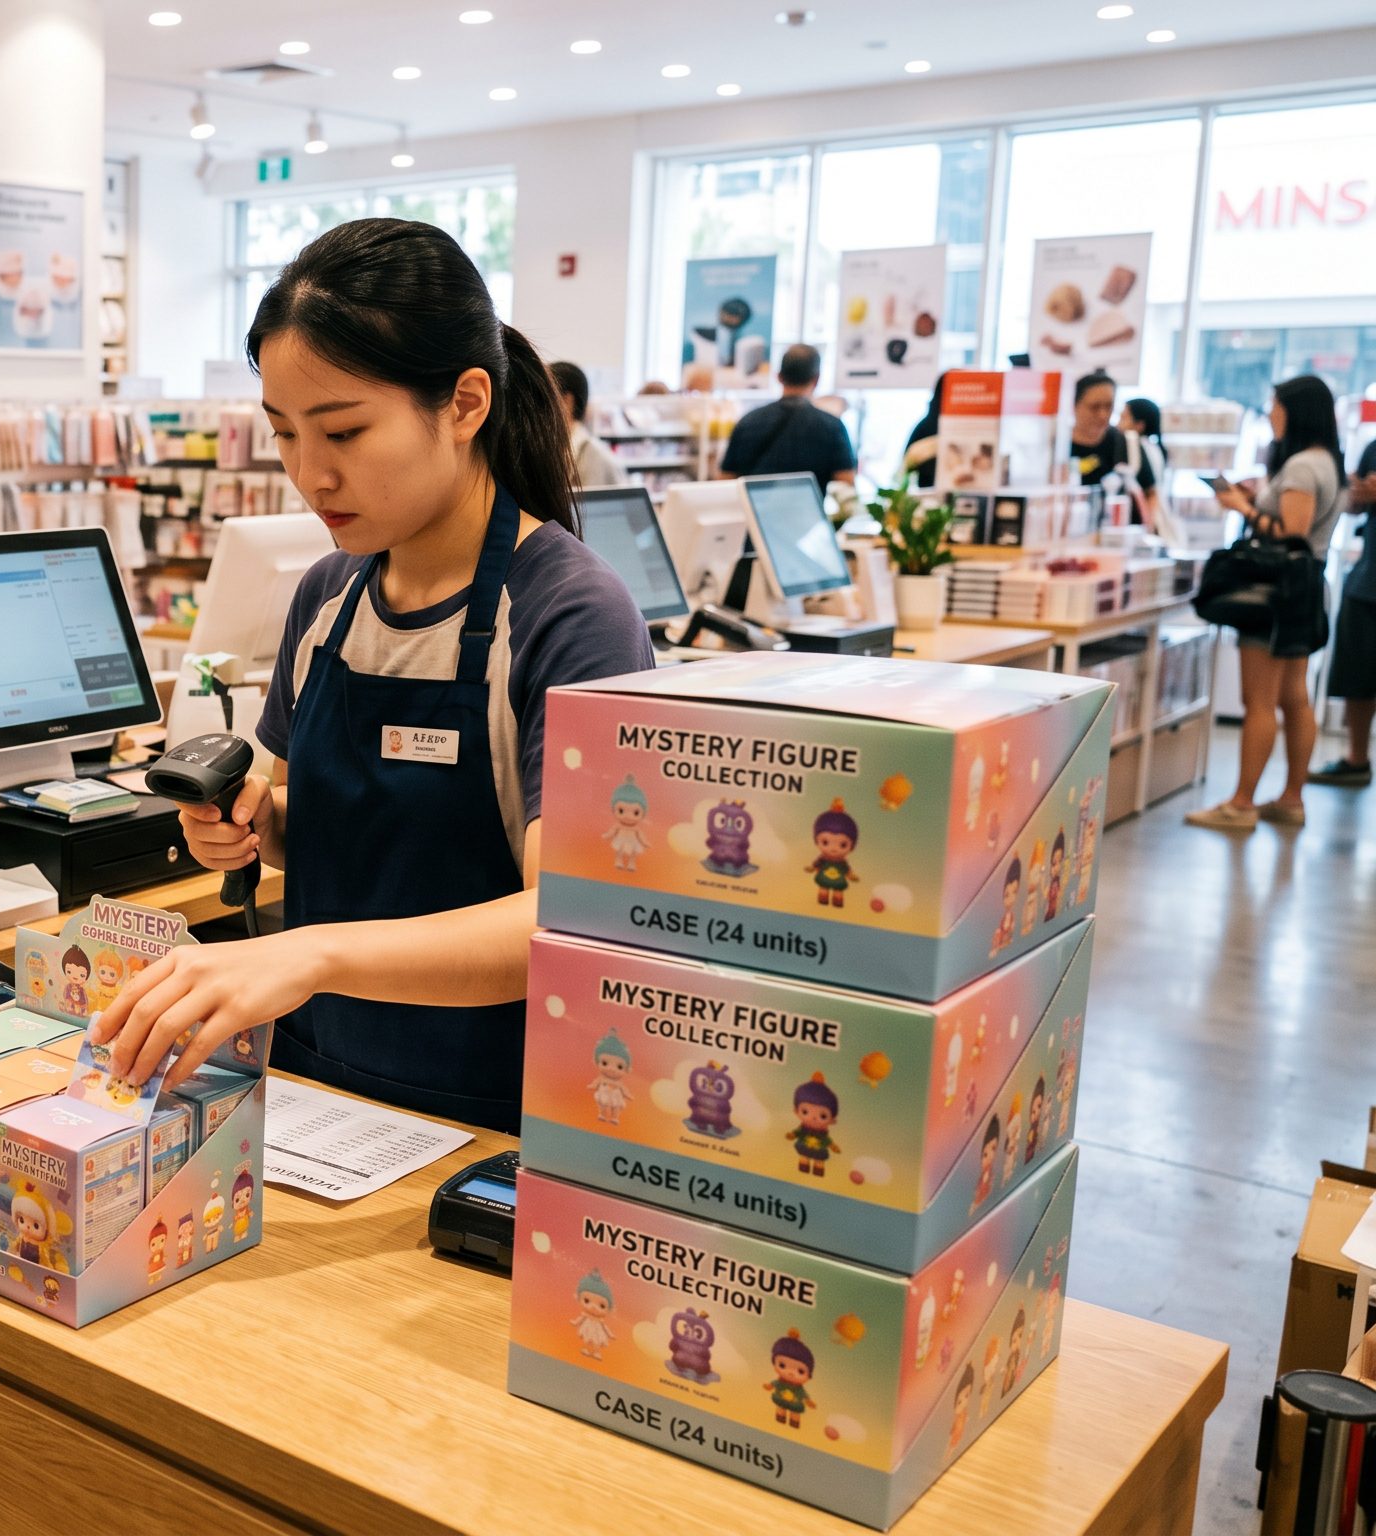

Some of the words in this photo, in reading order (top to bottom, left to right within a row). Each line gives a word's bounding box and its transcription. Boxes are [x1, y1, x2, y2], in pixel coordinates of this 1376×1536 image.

[1215, 180, 1375, 231] MINS
[618, 725, 743, 760] MYSTERY
[751, 740, 858, 773] FIGURE
[663, 759, 803, 794] COLLECTION
[94, 902, 181, 941] MYSTERY
[630, 905, 699, 936] CASE
[706, 918, 745, 945] (24
[753, 931, 827, 965] units)
[602, 979, 725, 1023] MYSTERY
[733, 1005, 838, 1047] FIGURE
[644, 1016, 785, 1062] COLLECTION
[2, 1139, 65, 1176] MYSTERY
[612, 1156, 681, 1192] CASE
[688, 1175, 726, 1204] (24
[734, 1191, 808, 1230] units)
[584, 1218, 706, 1271] MYSTERY
[712, 1256, 815, 1306] FIGURE
[627, 1259, 763, 1315] COLLECTION
[595, 1390, 662, 1431] CASE
[670, 1417, 706, 1446] (24
[713, 1437, 784, 1479] units)
